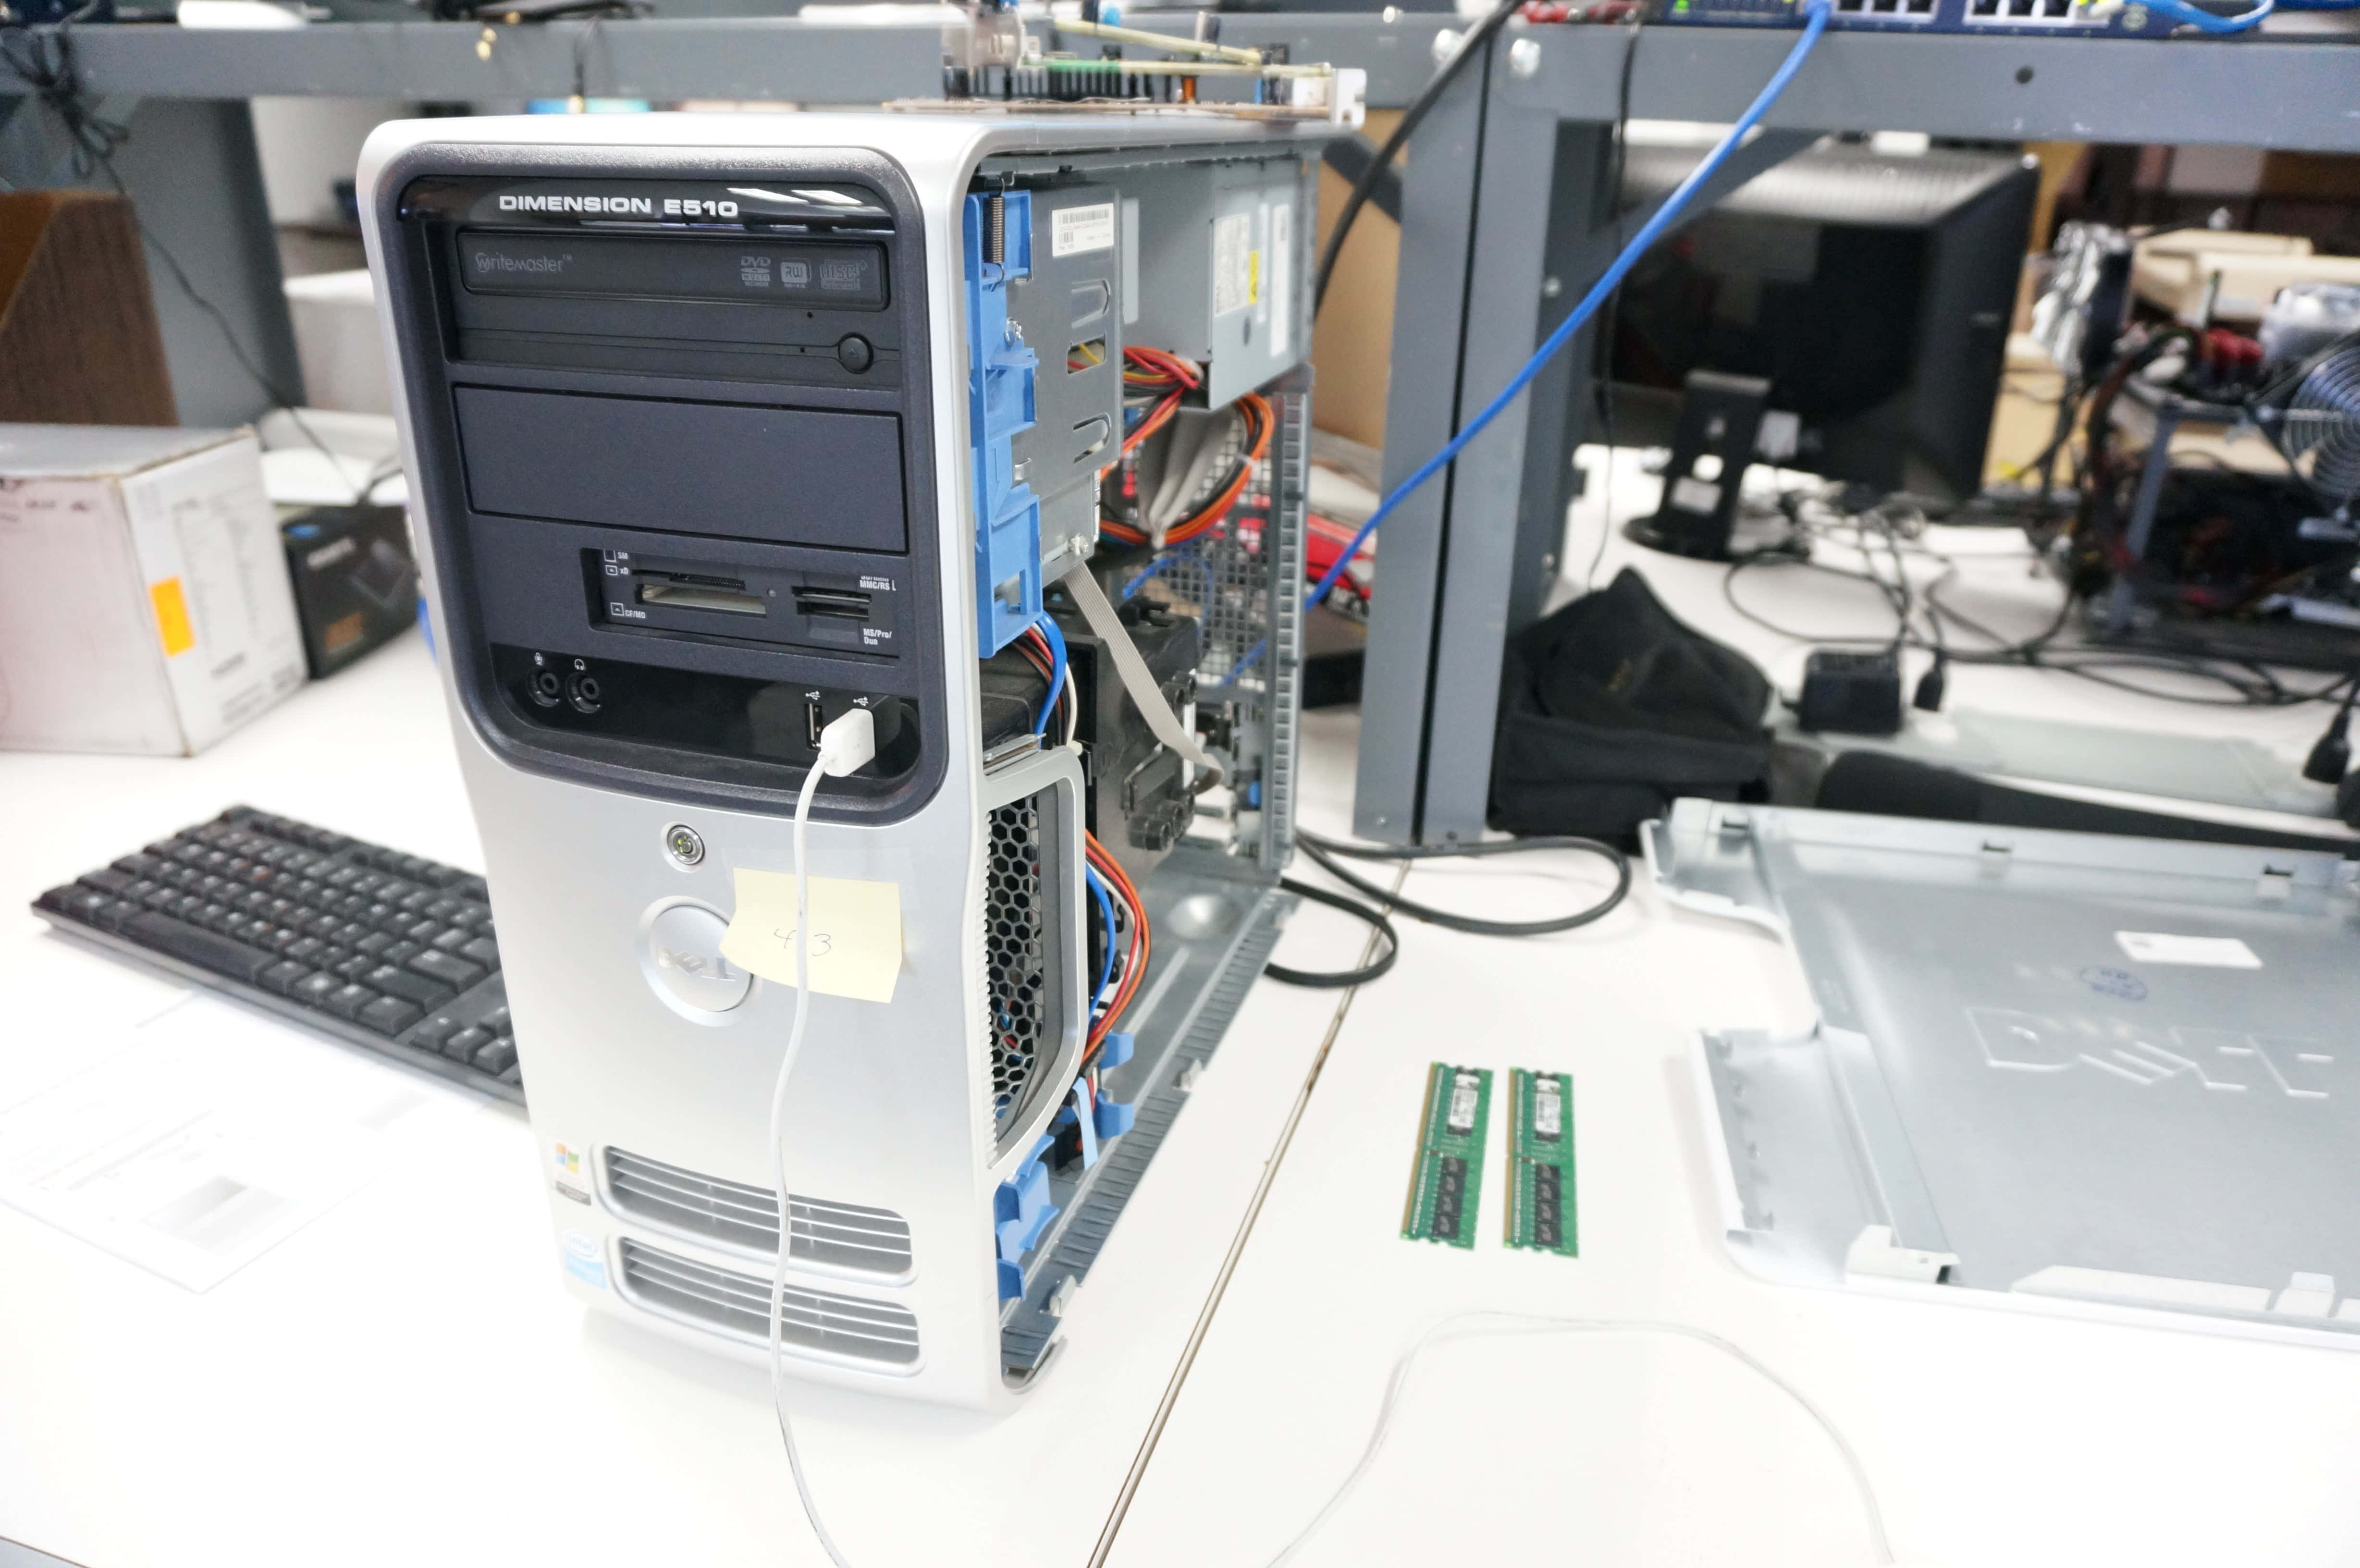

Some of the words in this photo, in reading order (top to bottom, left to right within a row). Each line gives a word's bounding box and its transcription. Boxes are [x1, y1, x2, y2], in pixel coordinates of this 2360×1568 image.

[499, 196, 651, 214] DIMENSION
[664, 199, 738, 218] E510
[740, 256, 771, 267] DVD
[785, 266, 803, 278] RW
[617, 551, 628, 560] SM
[860, 579, 890, 591] MMC/RS
[625, 610, 646, 619] CF/MD
[863, 628, 892, 638] MS/Pro/
[864, 637, 878, 645] Duo
